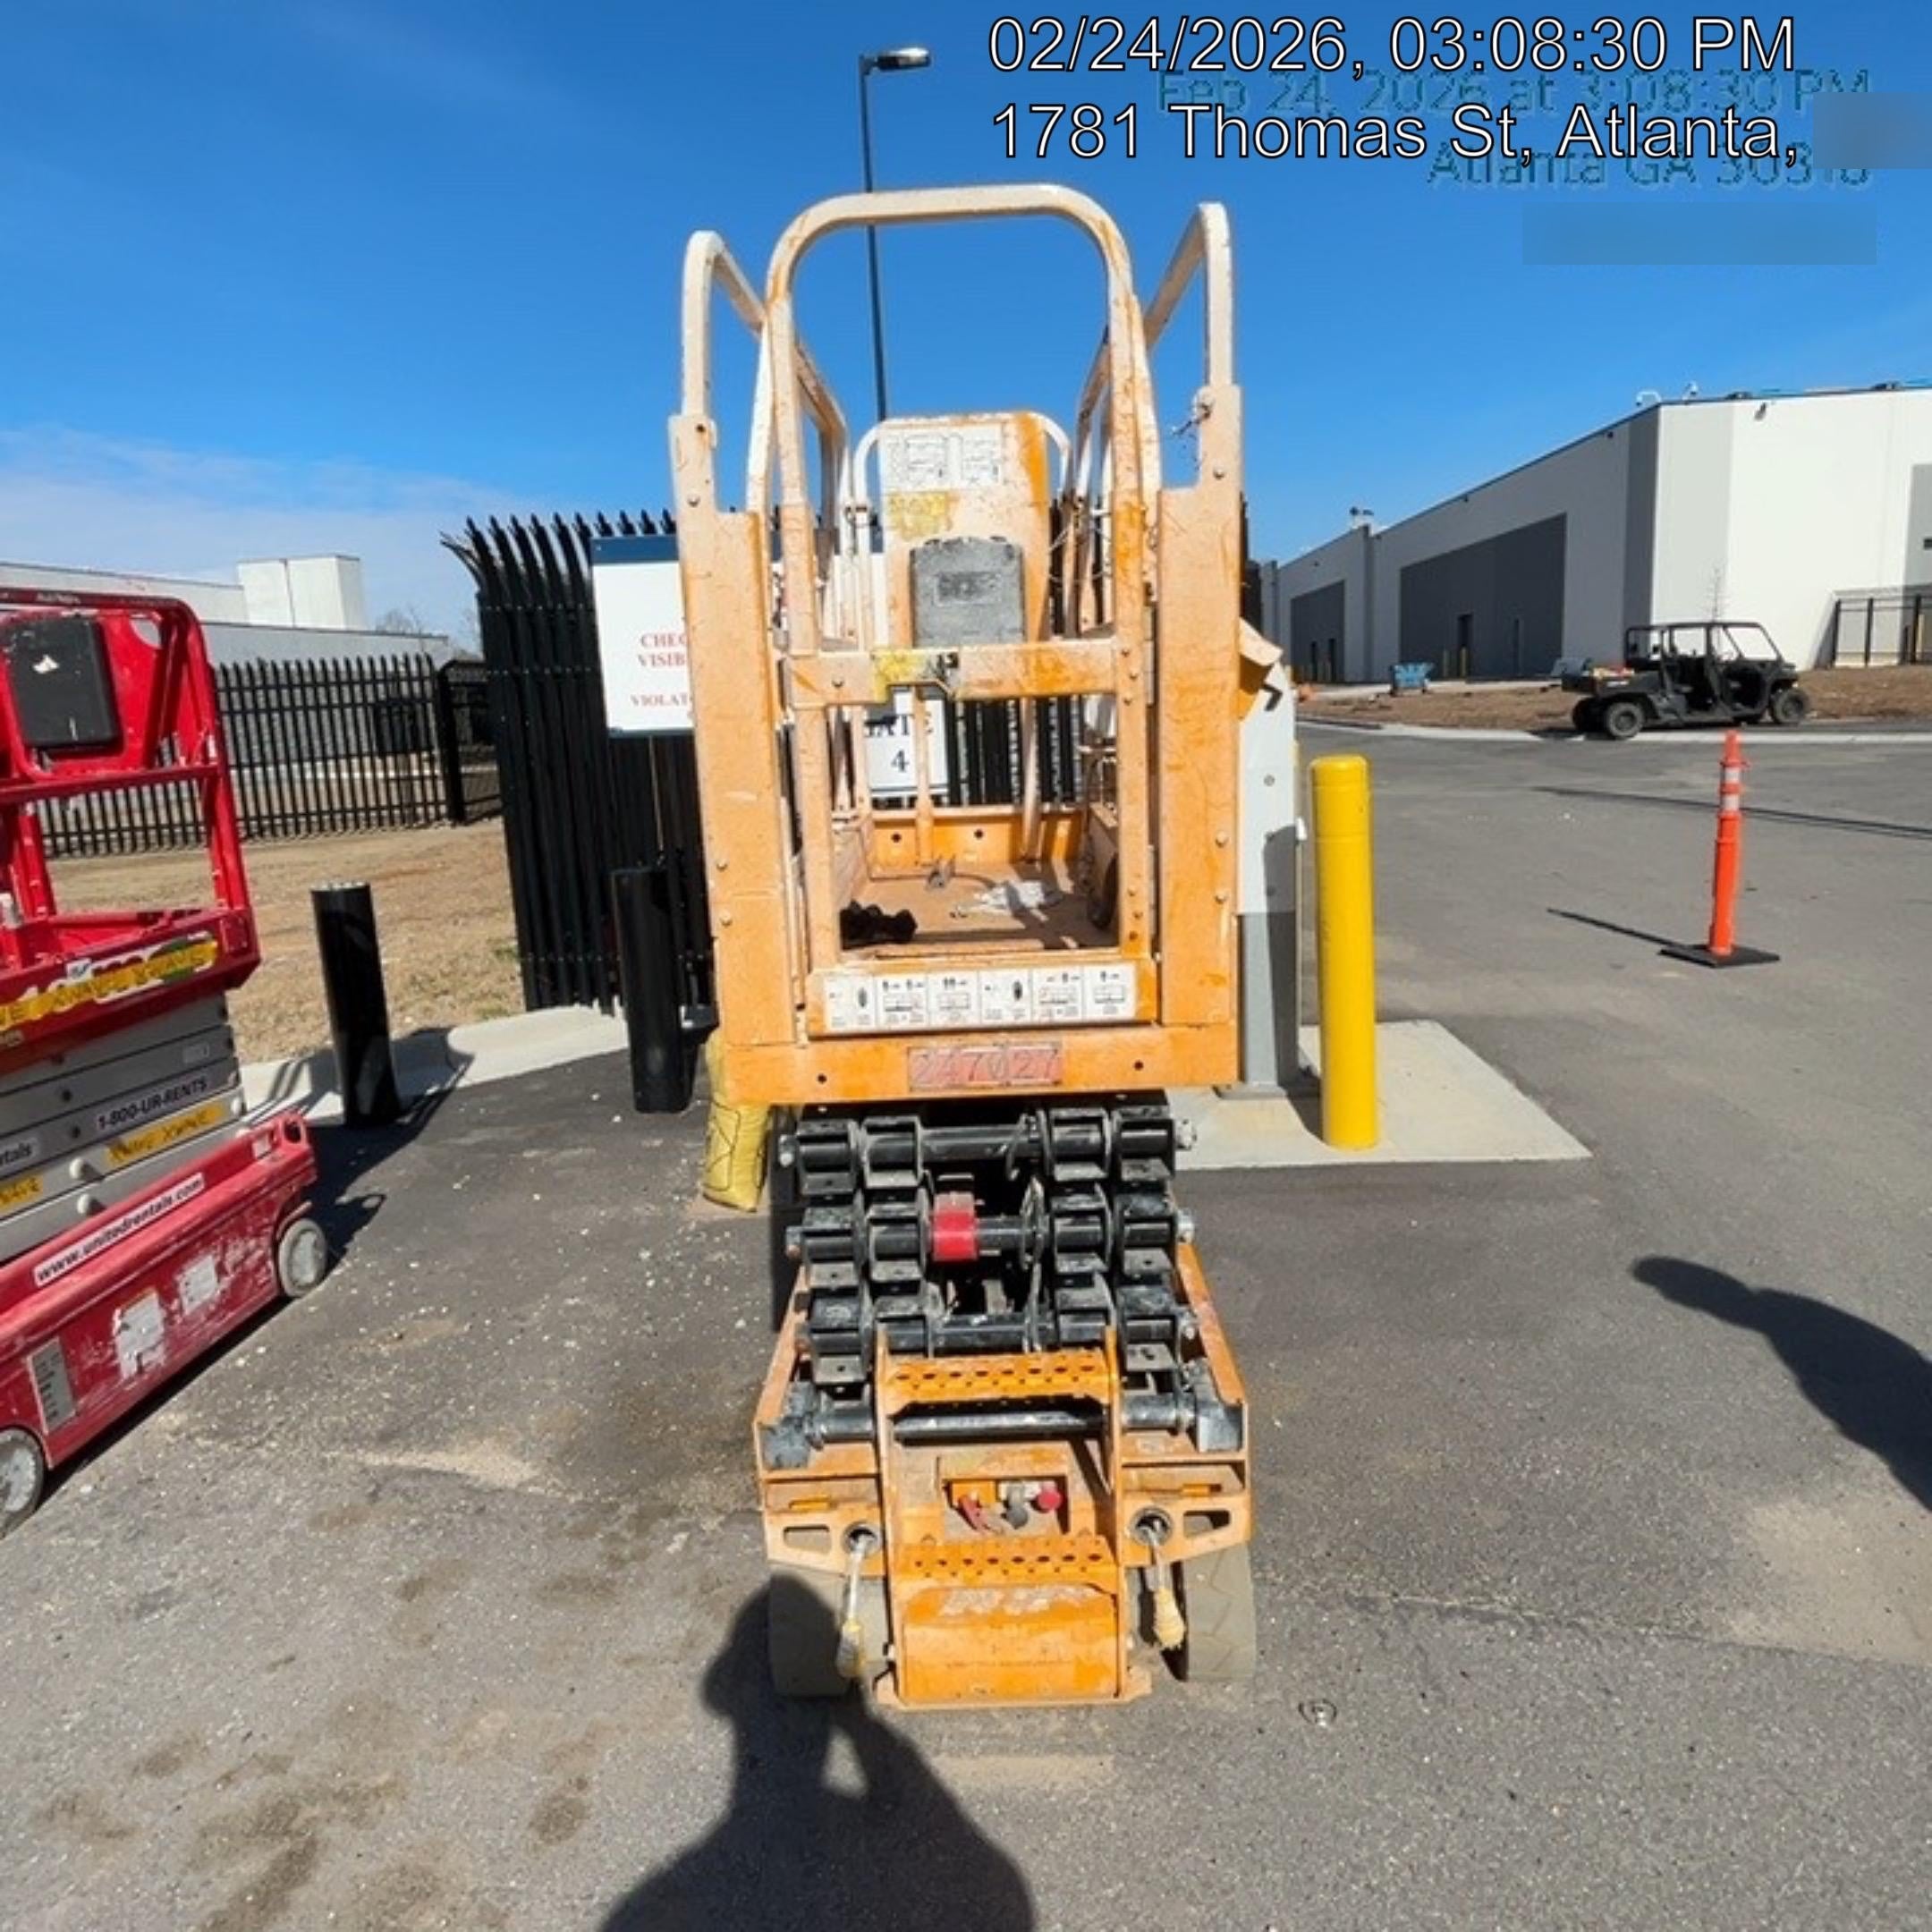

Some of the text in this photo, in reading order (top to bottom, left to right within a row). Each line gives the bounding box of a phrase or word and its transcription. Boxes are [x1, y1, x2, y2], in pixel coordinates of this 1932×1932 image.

[891, 750, 910, 773] 4
[97, 1075, 208, 1130] 1-800-UR-RENTS
[38, 1179, 201, 1282] www.unitedrentals.com
